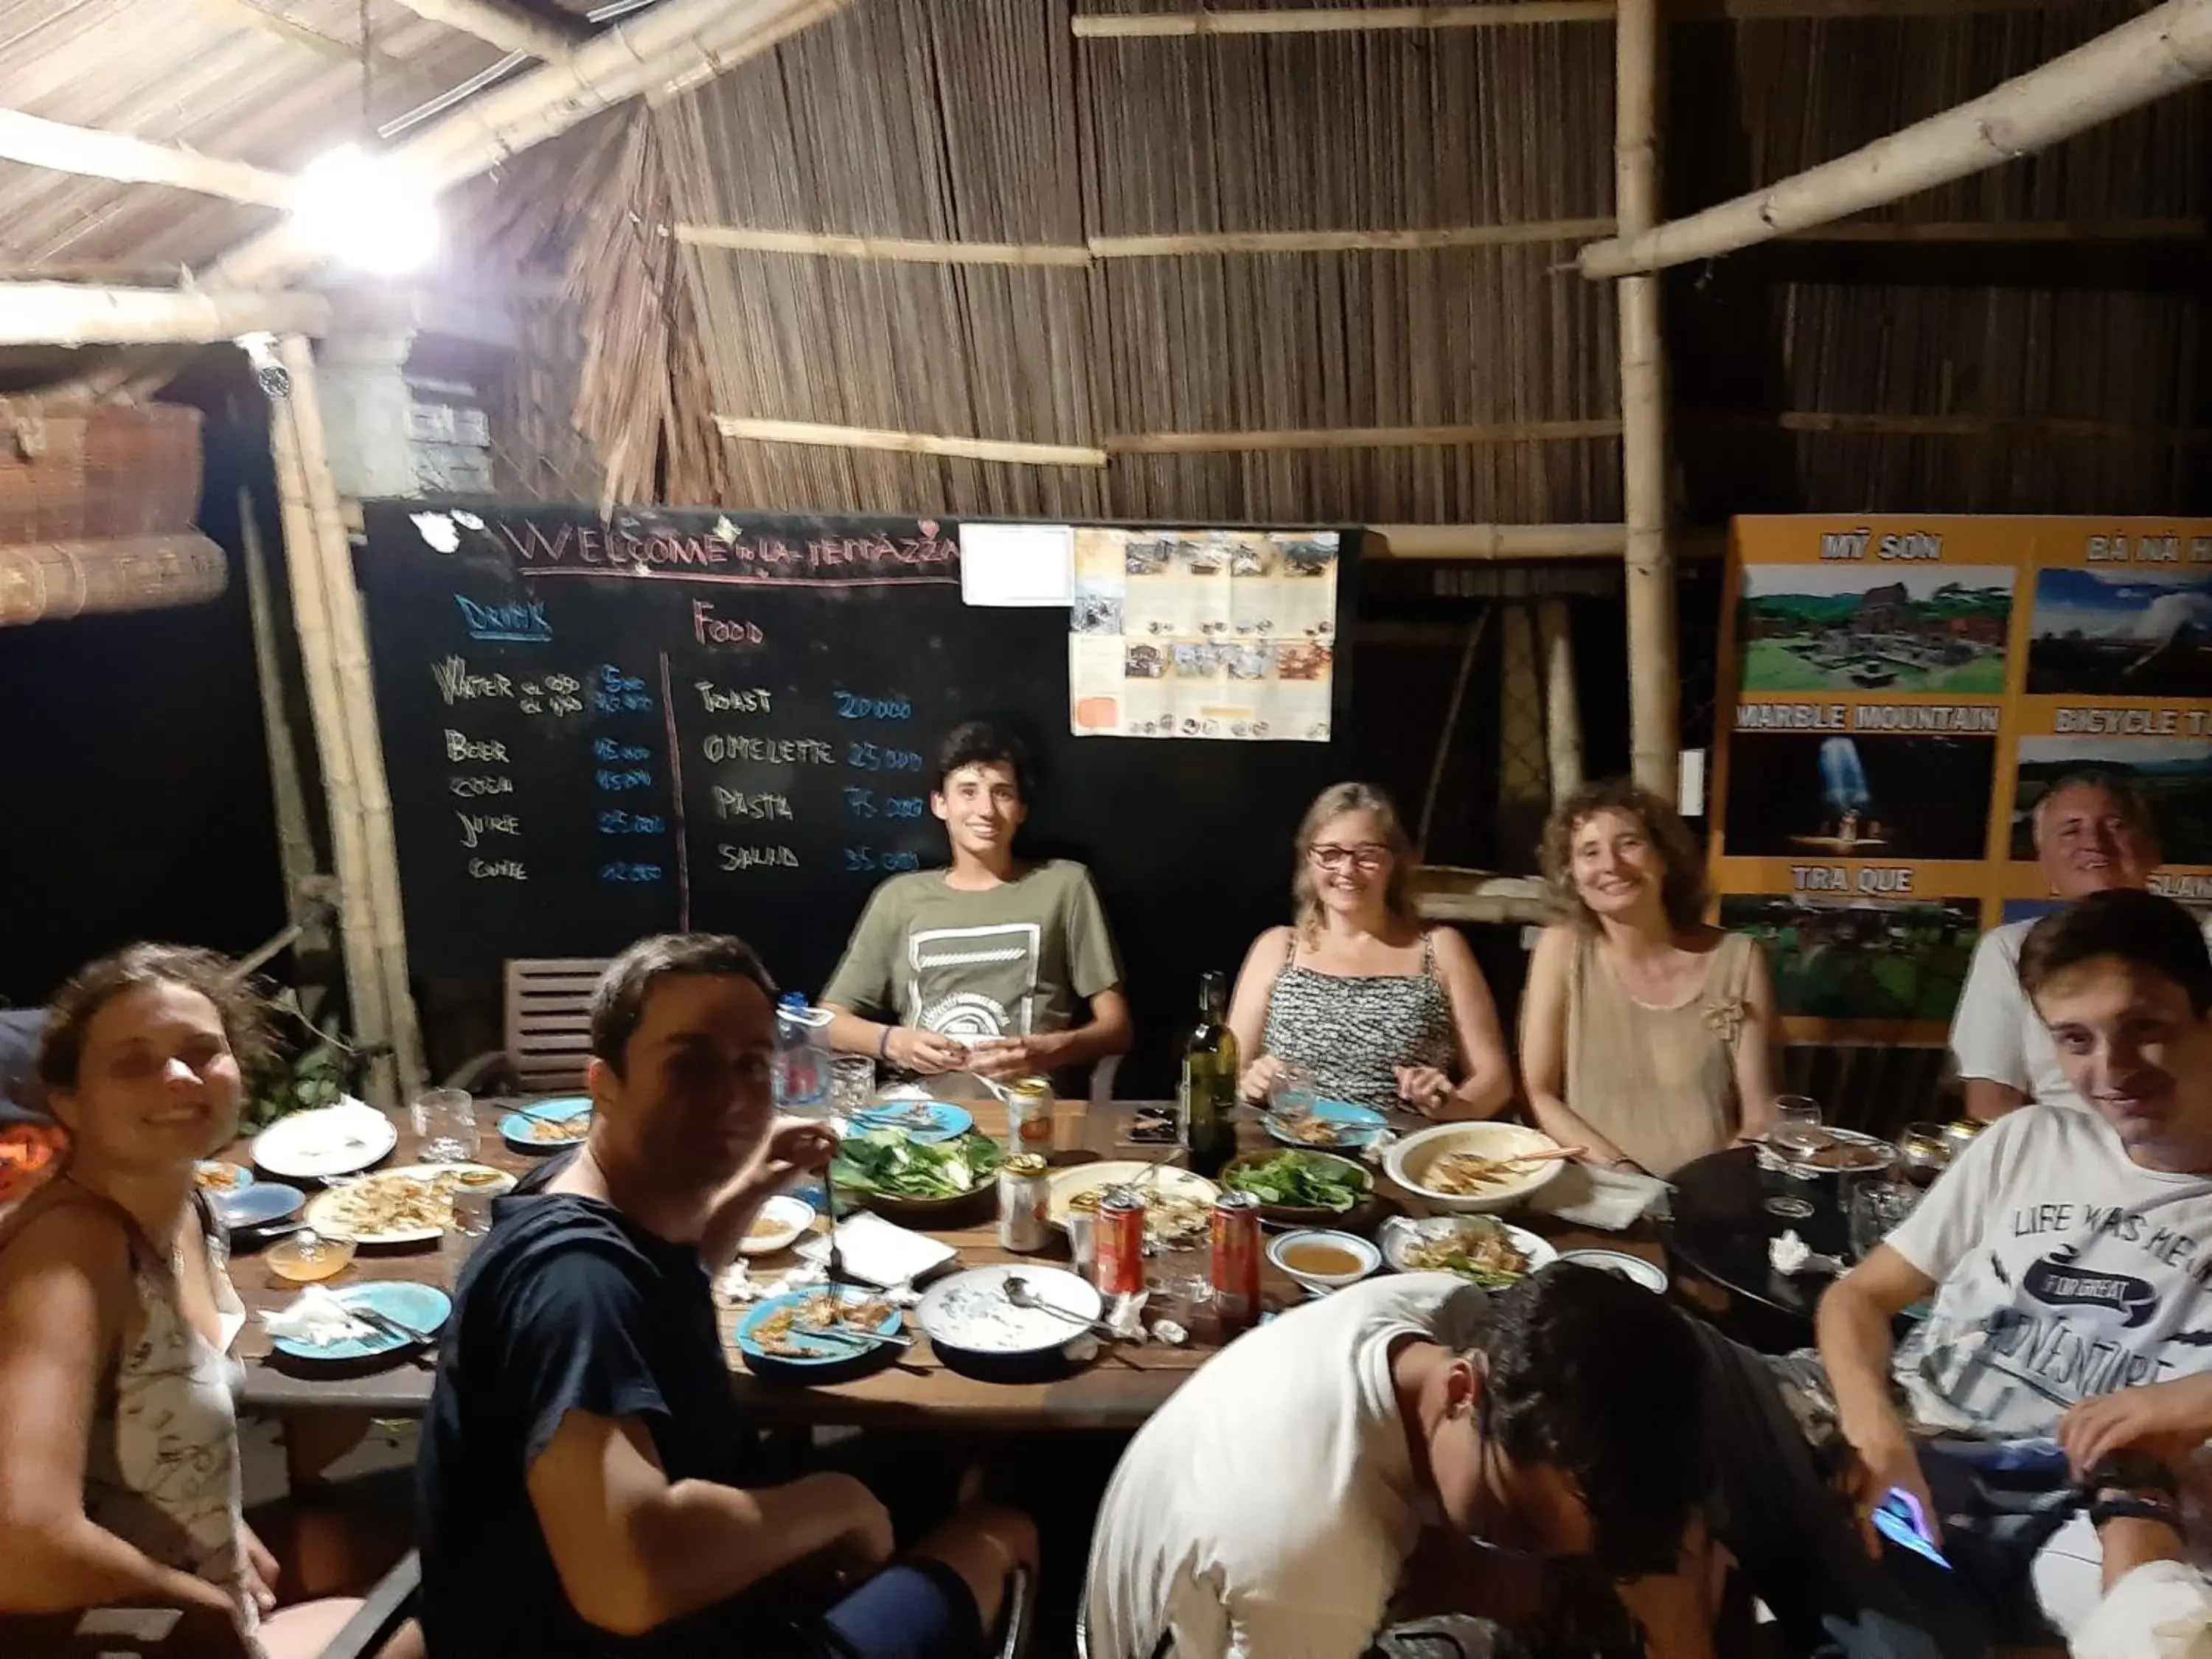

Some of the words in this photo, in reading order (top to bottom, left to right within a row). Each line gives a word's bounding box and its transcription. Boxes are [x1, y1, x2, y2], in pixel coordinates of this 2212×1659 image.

[1735, 703, 1848, 729] MARBLE
[1854, 704, 2001, 731] MOUNTAIN
[2053, 708, 2179, 735] BICYCLE
[1792, 865, 1848, 891] TRA
[1856, 866, 1914, 895] QUE
[2013, 1203, 2075, 1238] LIFE
[2083, 1203, 2148, 1242] WAS
